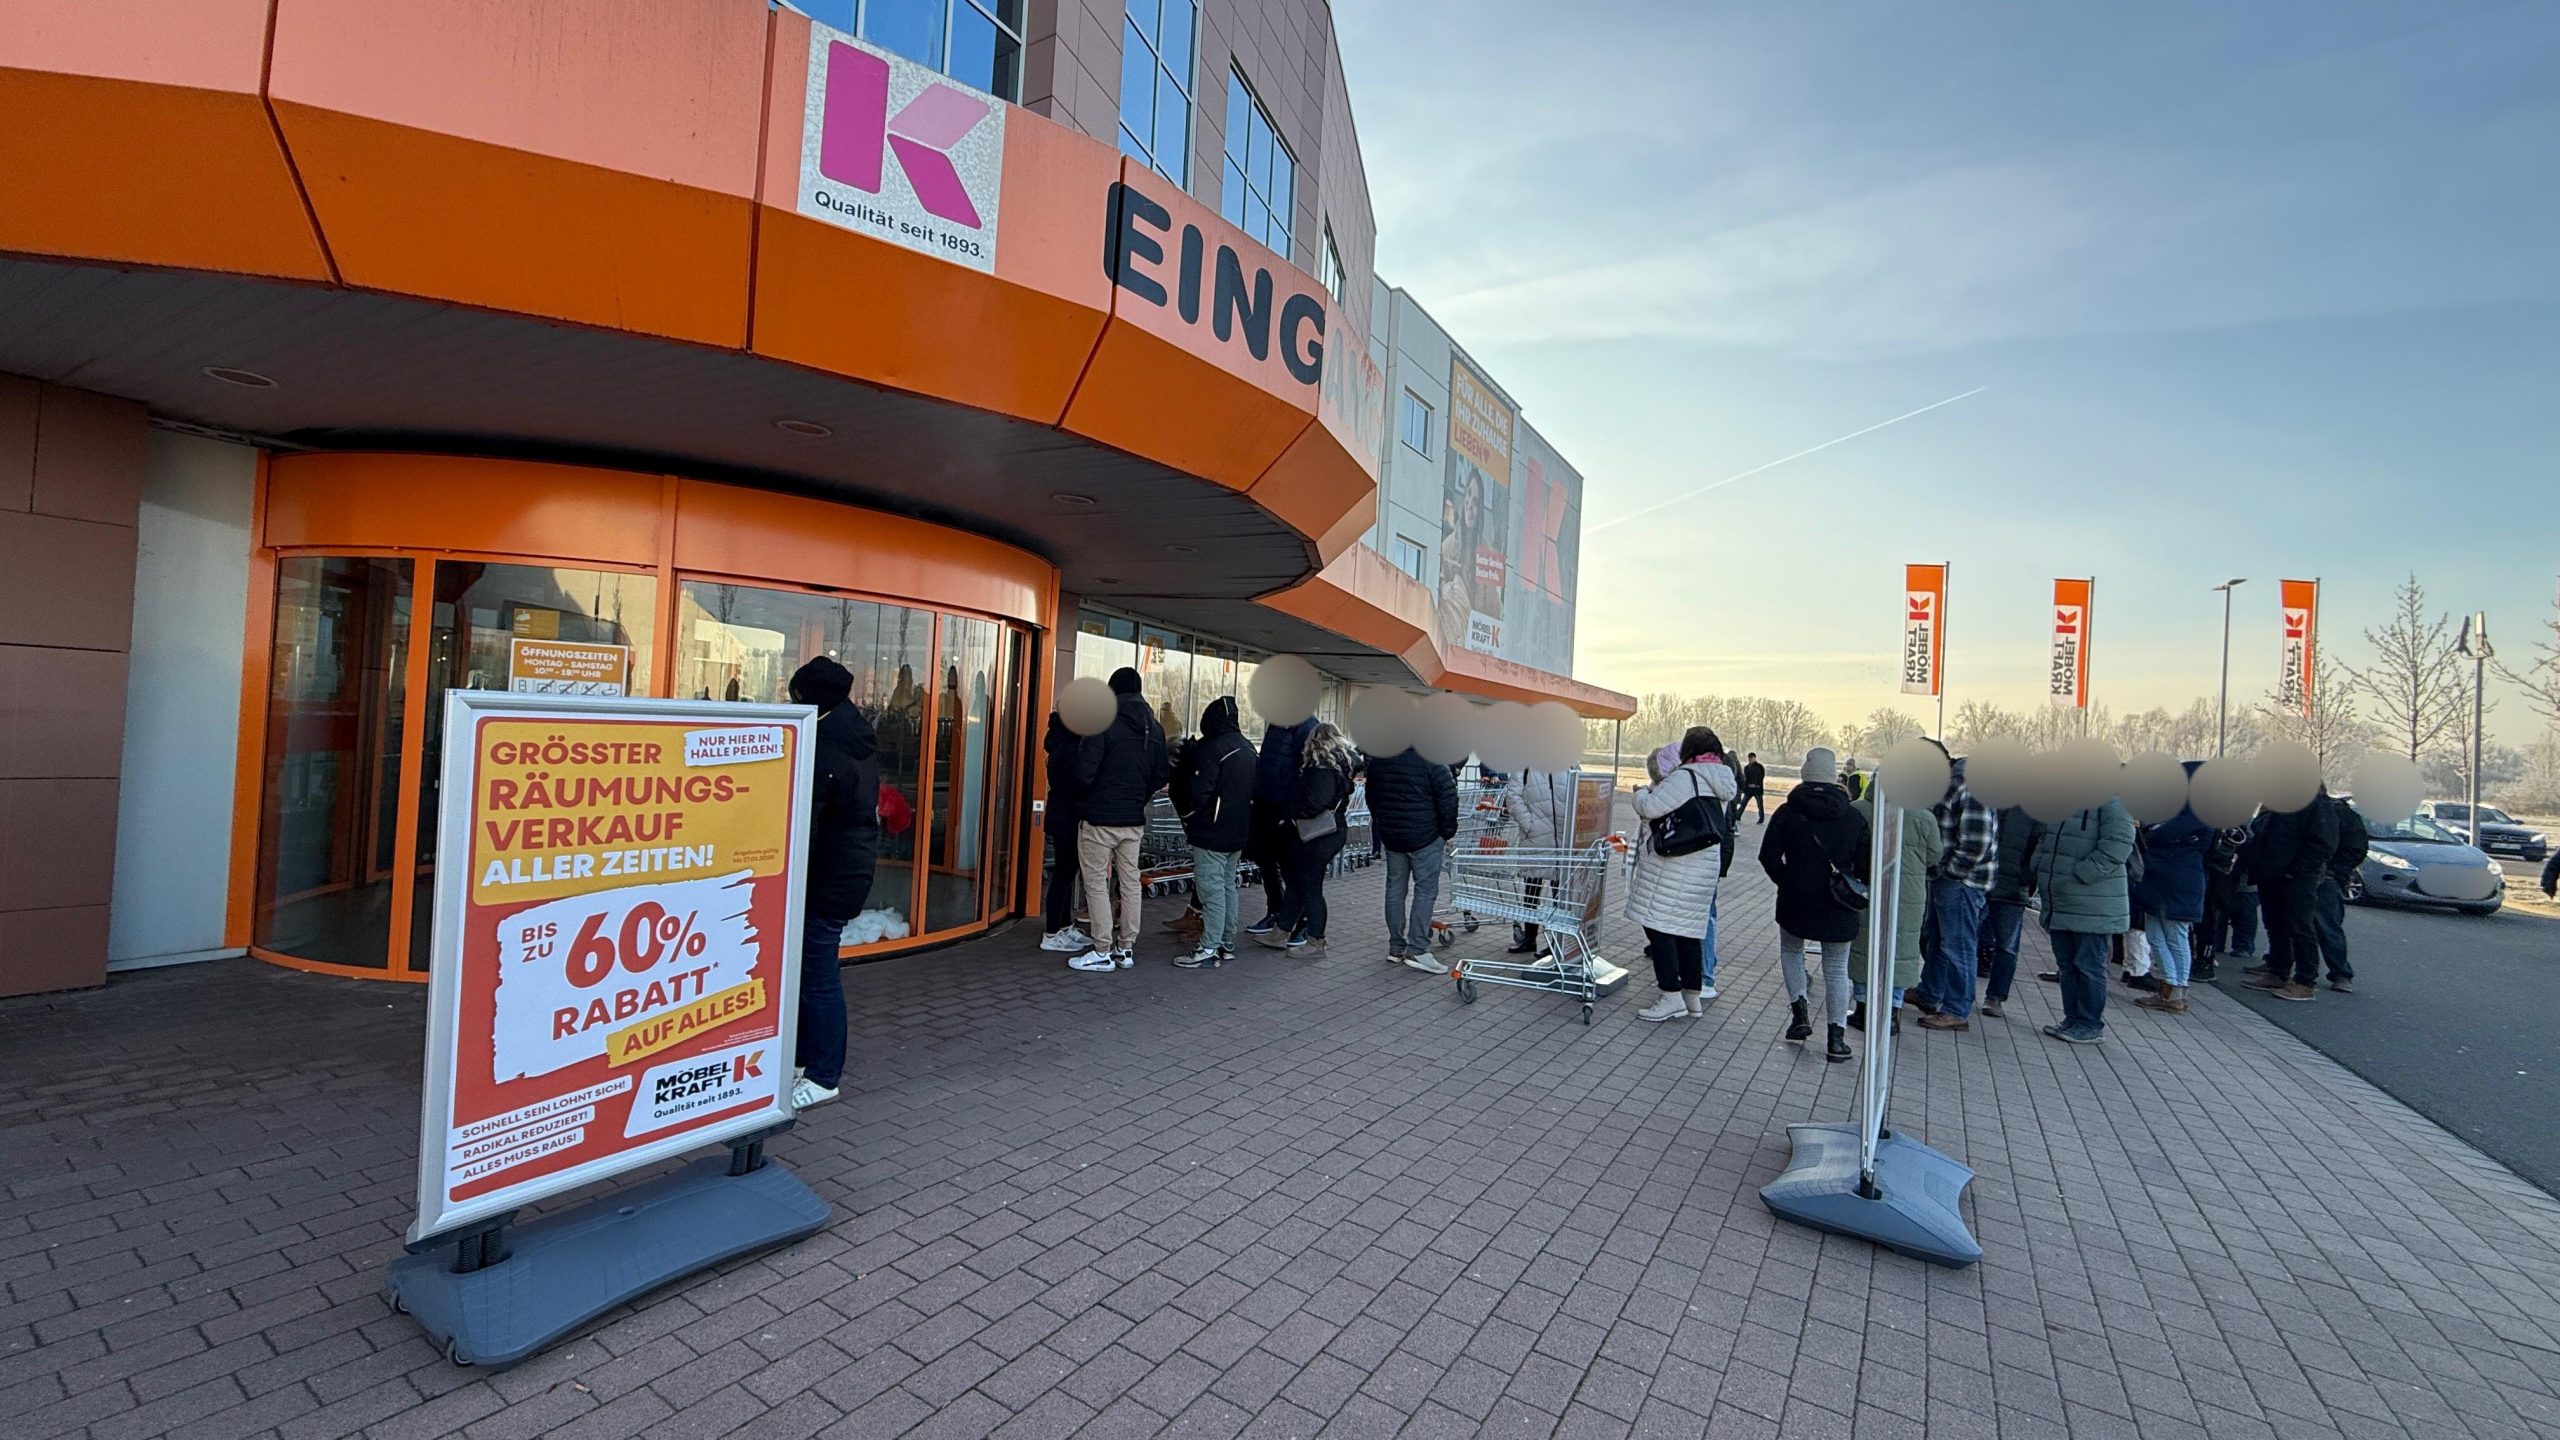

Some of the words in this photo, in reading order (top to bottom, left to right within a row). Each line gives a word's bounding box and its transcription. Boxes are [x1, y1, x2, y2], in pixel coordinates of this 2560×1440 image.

[815, 190, 894, 230] Qualität
[900, 222, 935, 243] seit
[940, 233, 985, 259] 1893.
[1456, 373, 1474, 405] FÜR
[1495, 410, 1508, 436] DIE
[1454, 421, 1483, 461] LIEBEN
[1455, 398, 1472, 428] IHR
[1471, 413, 1508, 458] ZUHAUSE
[1471, 630, 1490, 645] KRAFT
[1472, 619, 1491, 635] MÖBEL
[521, 646, 618, 662] ÖFFNUNGSZEITEN
[524, 658, 563, 667] MONTAG
[571, 661, 613, 671] SAMSTAG
[581, 670, 602, 678] UHR
[490, 734, 662, 766] GRÖSSTER
[691, 747, 730, 759] HALLE
[699, 736, 726, 747] NUR
[729, 734, 755, 745] HIER
[758, 733, 771, 743] IN
[489, 771, 750, 811] RÄUMUNGS-
[485, 812, 684, 852] VERKAUF
[481, 852, 595, 887] ALLER
[601, 844, 714, 876] ZEITEN!
[521, 922, 558, 944] BIS
[565, 900, 707, 989] 60%
[521, 941, 554, 963] ZU
[622, 1018, 674, 1057] AUF
[677, 987, 756, 1035] ALLES!
[654, 1075, 727, 1105] KRAFT
[655, 1061, 732, 1091] MÖBEL
[461, 1114, 524, 1139] SCHNELL
[524, 1103, 551, 1120] SEIN
[553, 1090, 593, 1111] LOHNT
[594, 1080, 626, 1098] SICH!
[653, 1101, 696, 1119] Qualität
[697, 1095, 716, 1107] seit
[717, 1087, 744, 1102] 1893.
[463, 1134, 519, 1160] RADIKAL
[521, 1110, 589, 1141] REDUZIERT!
[462, 1158, 502, 1180] ALLES
[504, 1146, 540, 1166] MUSS
[542, 1133, 578, 1153] RAUS!
